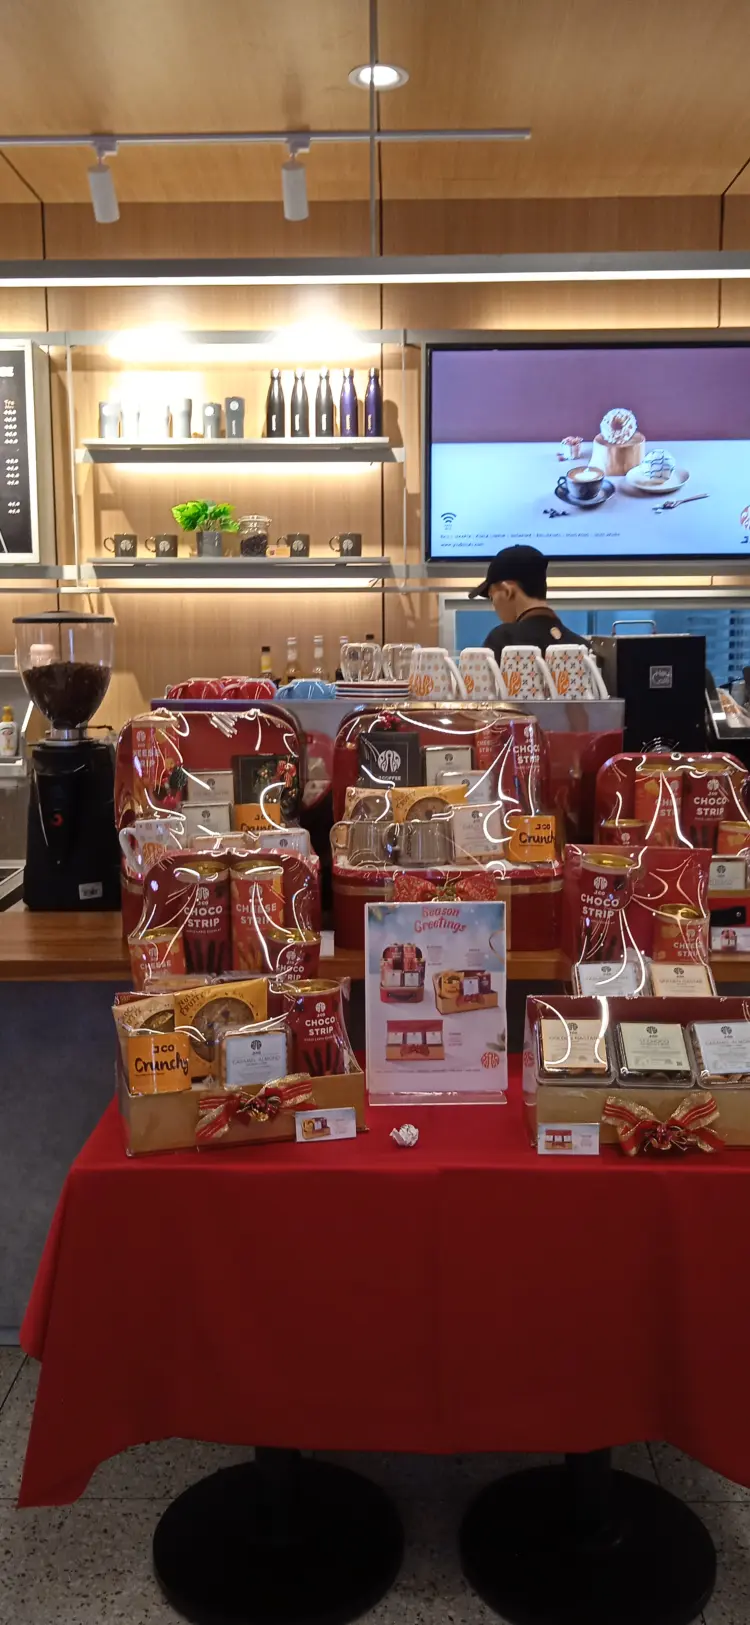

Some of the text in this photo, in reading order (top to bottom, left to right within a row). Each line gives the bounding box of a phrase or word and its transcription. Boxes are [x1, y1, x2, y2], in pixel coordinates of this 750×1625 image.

[693, 796, 726, 806] CHOCO
[695, 807, 725, 817] STRIP
[580, 893, 620, 907] CHOCO
[183, 905, 223, 917] CHOCO
[582, 906, 615, 919] STRIP
[187, 917, 220, 929] STRIP
[304, 1016, 336, 1027] CHOCO
[308, 1026, 334, 1036] STRIP
[134, 1052, 190, 1076] Crunchy
